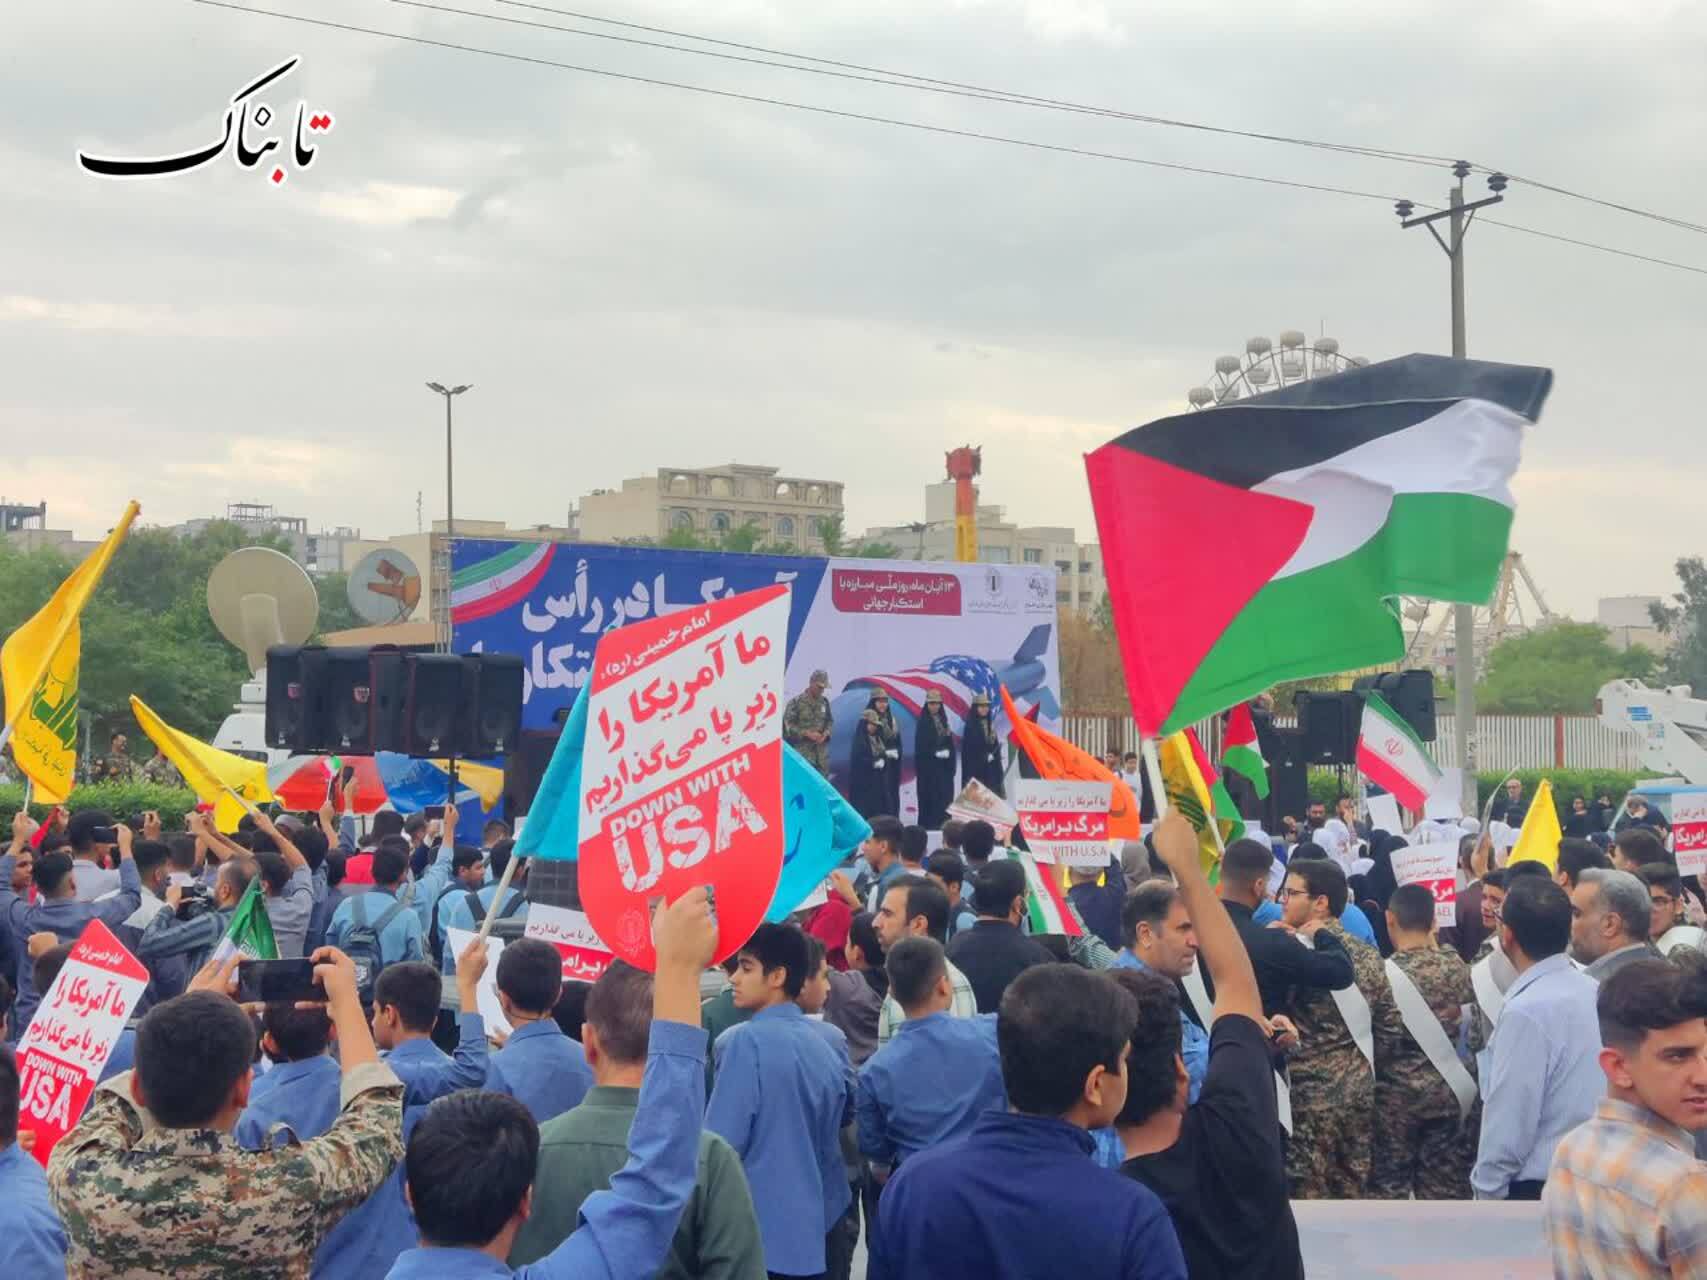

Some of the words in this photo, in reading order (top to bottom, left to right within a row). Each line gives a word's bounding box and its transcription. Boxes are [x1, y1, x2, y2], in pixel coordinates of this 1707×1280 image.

[521, 558, 604, 633] رأس
[680, 609, 711, 639] امام
[633, 627, 681, 667] خمینی
[733, 631, 771, 665] ما
[628, 634, 728, 724] آمریکا
[710, 706, 734, 745] پا
[742, 684, 778, 733] زیر
[597, 707, 626, 755] را
[609, 787, 684, 839] DOWN
[686, 752, 751, 798] WITH
[611, 780, 769, 893] USA
[1023, 815, 1056, 836] امریکا
[1053, 819, 1073, 837] بر
[1074, 814, 1105, 838] مرگ
[52, 972, 67, 1009] را
[68, 975, 114, 1019] آمریکا
[110, 982, 126, 1018] ما
[79, 1028, 92, 1060] پا
[90, 1039, 109, 1067] زیر
[25, 1050, 56, 1076] DOWN
[54, 1062, 84, 1088] WITH
[19, 1067, 71, 1131] USA
